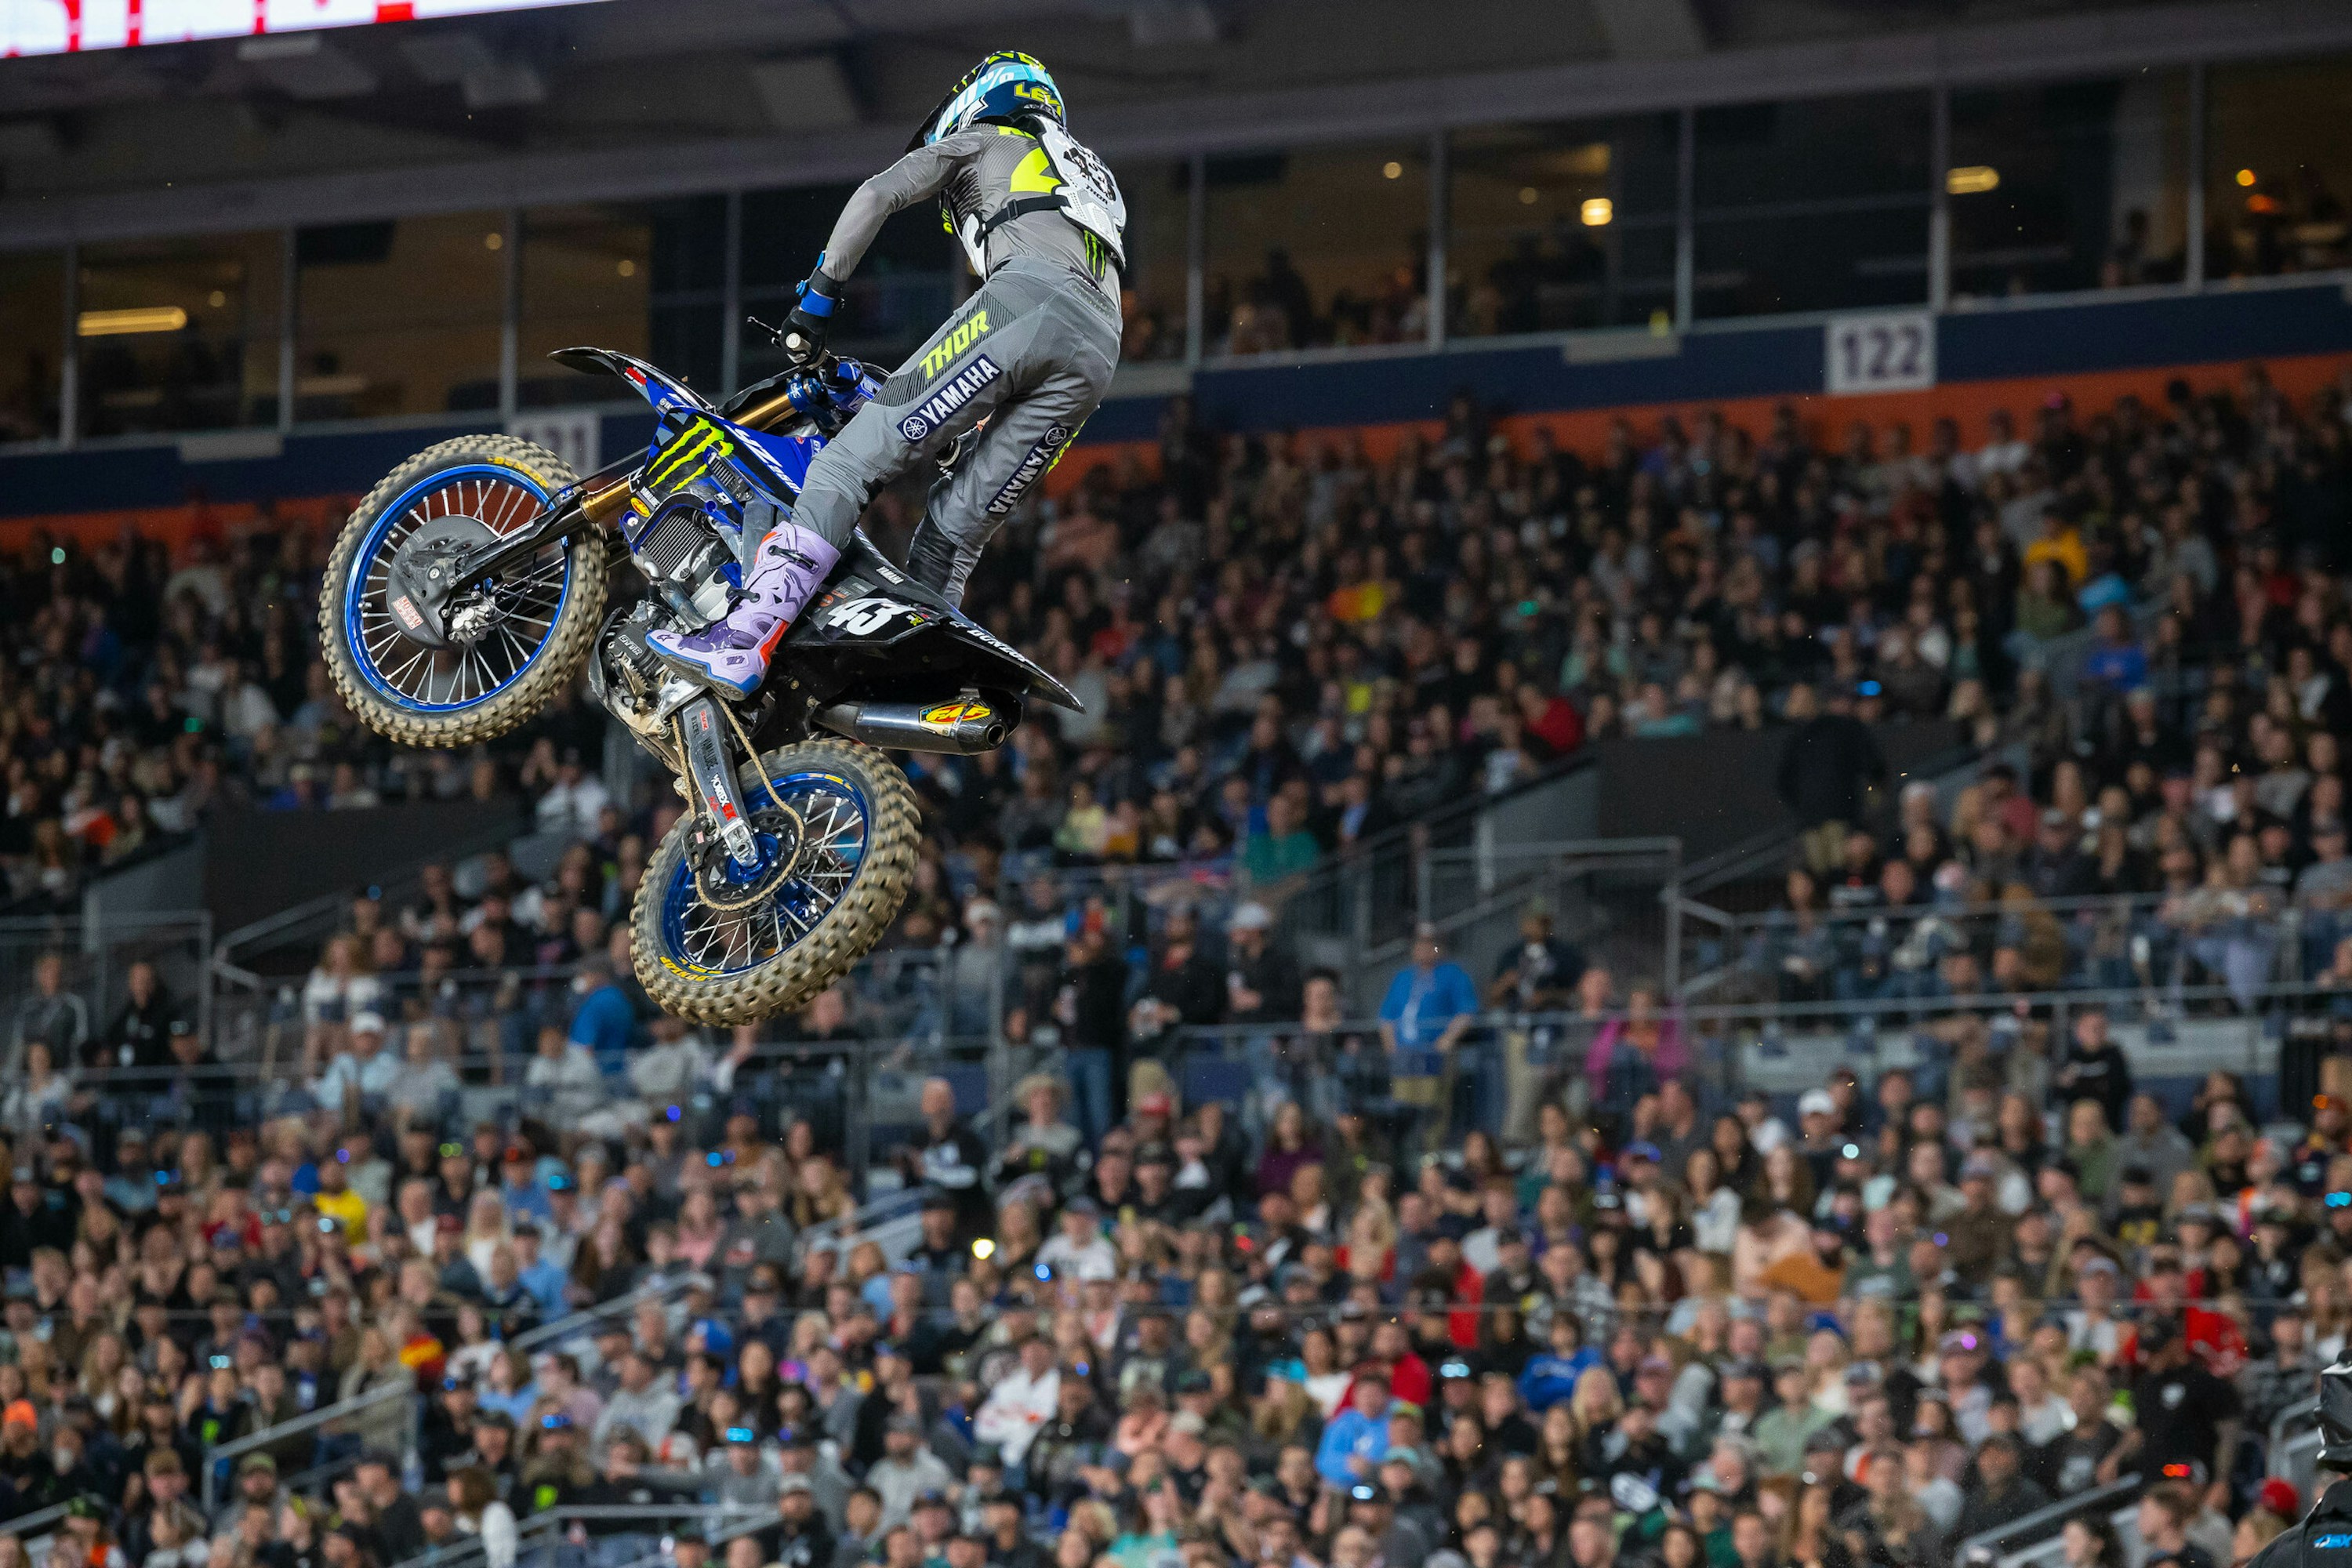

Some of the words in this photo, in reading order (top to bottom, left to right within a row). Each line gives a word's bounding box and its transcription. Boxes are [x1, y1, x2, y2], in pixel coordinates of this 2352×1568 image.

[919, 310, 990, 380] THOR
[1842, 326, 1922, 380] 122
[919, 358, 1000, 426] YAMAHA
[988, 445, 1054, 514] YAMAHA
[827, 597, 917, 636] 43
[710, 773, 730, 808] VORTEX
